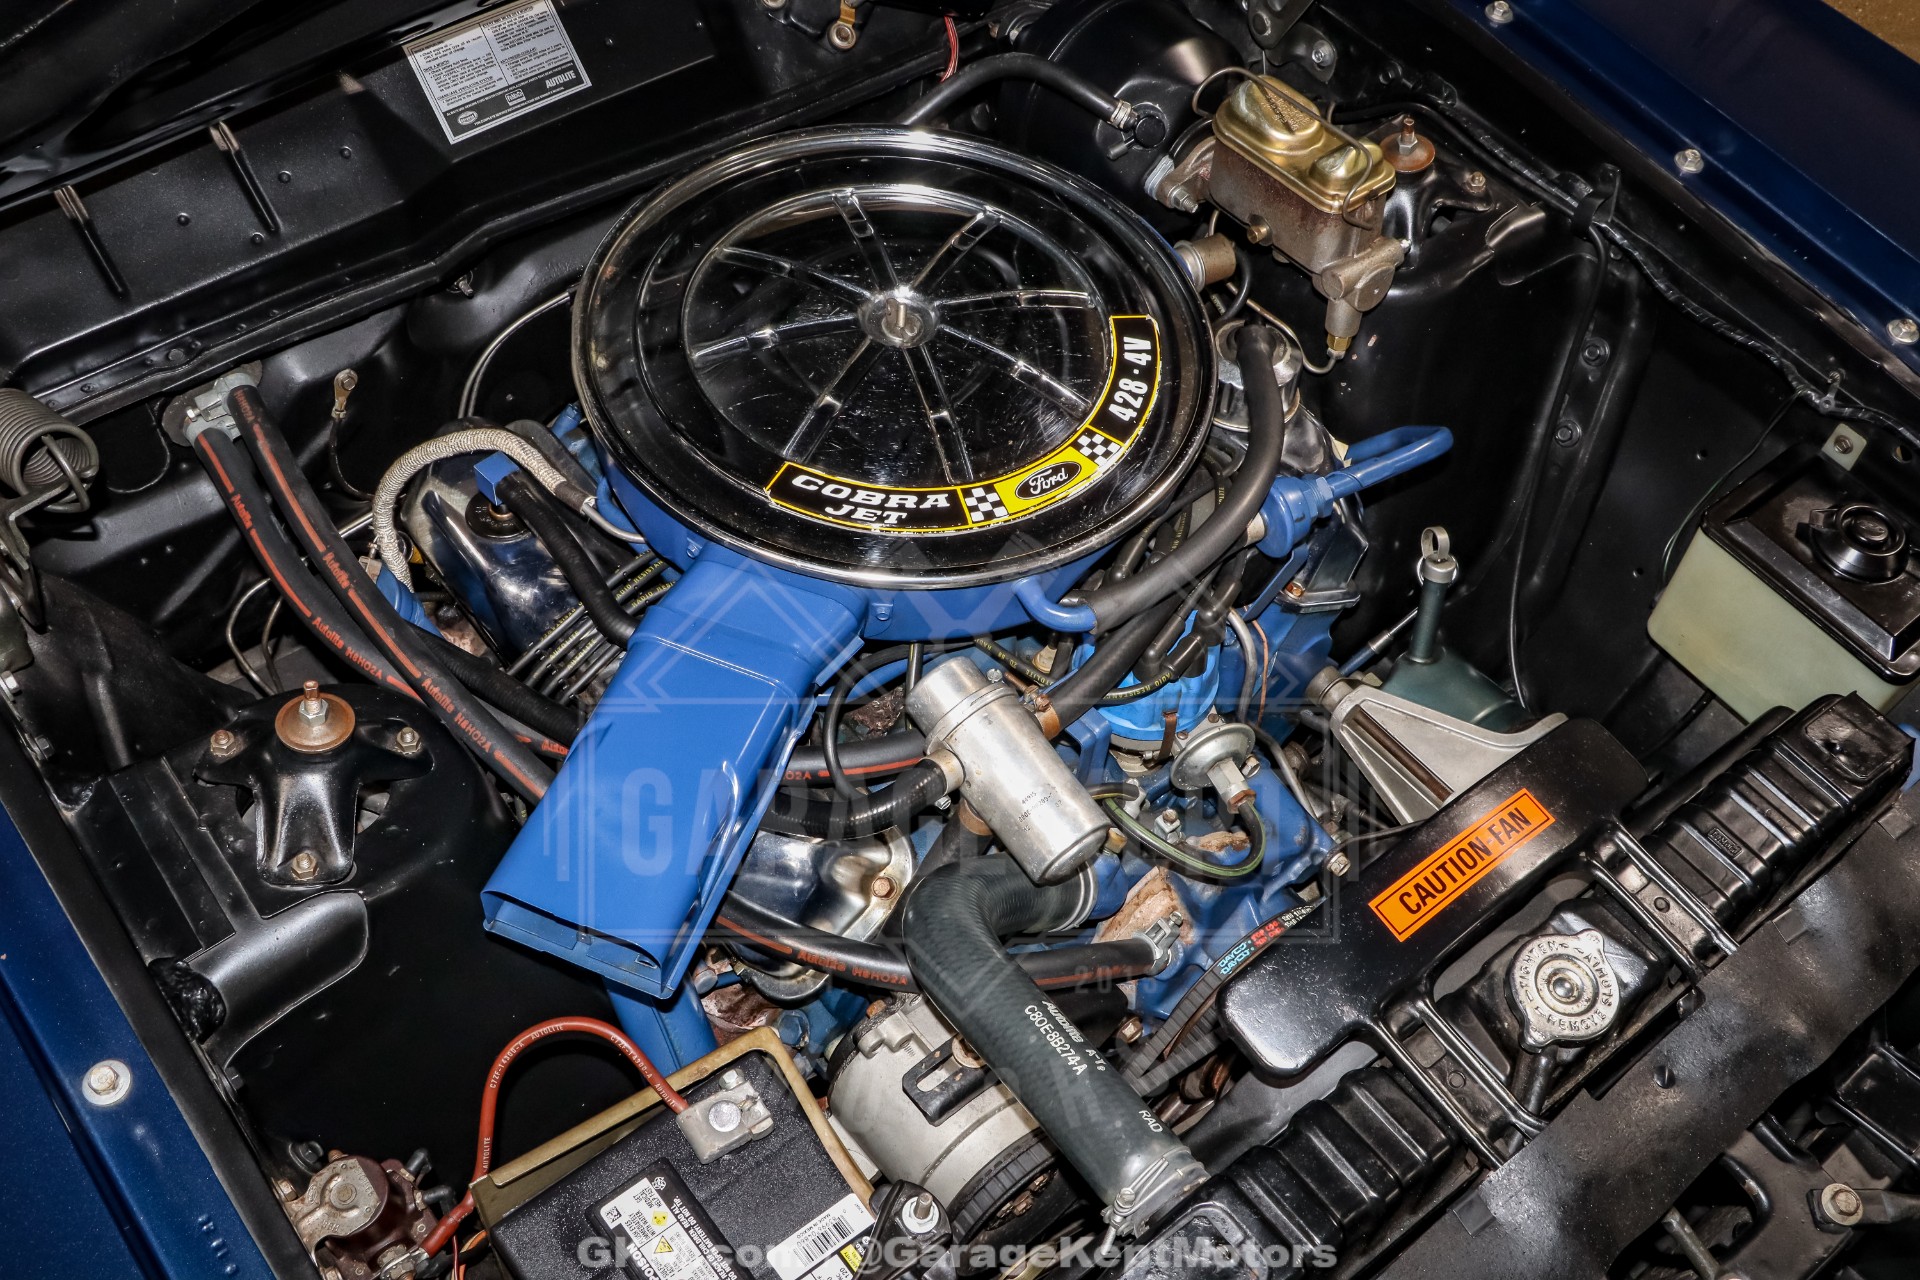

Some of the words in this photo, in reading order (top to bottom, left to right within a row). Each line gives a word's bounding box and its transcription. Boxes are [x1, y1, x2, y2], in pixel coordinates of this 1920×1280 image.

[544, 69, 576, 89] AUTOLITE
[1109, 378, 1148, 423] 428
[1028, 466, 1070, 496] Ford
[792, 474, 950, 509] COBRA
[825, 506, 907, 525] JET
[547, 629, 581, 660] AUTOLITE
[563, 637, 599, 670] AUTOLITE
[1398, 835, 1494, 915] CAUTION
[1489, 806, 1533, 847] FAN
[1218, 943, 1246, 967] DAYCO
[1220, 950, 1250, 975] DAYCO
[1042, 1000, 1084, 1042] Autolite
[530, 1024, 564, 1041] AUTOLITE
[653, 1083, 676, 1107] AUTOLITE
[1139, 1109, 1164, 1133] RAD
[483, 1136, 491, 1172] AUTOLITE
[632, 1192, 642, 1203] GET
[637, 1188, 654, 1209] MEDICAL
[644, 1185, 654, 1196] FAST
[650, 1193, 662, 1208] HELP
[669, 1202, 680, 1214] ALL
[672, 1194, 683, 1207] TIP.
[677, 1213, 690, 1228] READ
[680, 1205, 691, 1217] NOT
[687, 1215, 696, 1225] DO
[817, 1212, 831, 1223] MADE
[624, 1219, 635, 1231] EYES
[645, 1224, 656, 1237] WITH
[795, 1225, 814, 1238] MEXICO
[686, 1226, 710, 1255] CHILDREN.
[706, 1253, 715, 1262] OF
[709, 1245, 723, 1262] OPEN
[663, 1261, 675, 1274] ACID
[711, 1260, 727, 1279] REACH
[720, 1260, 731, 1272] NOT
